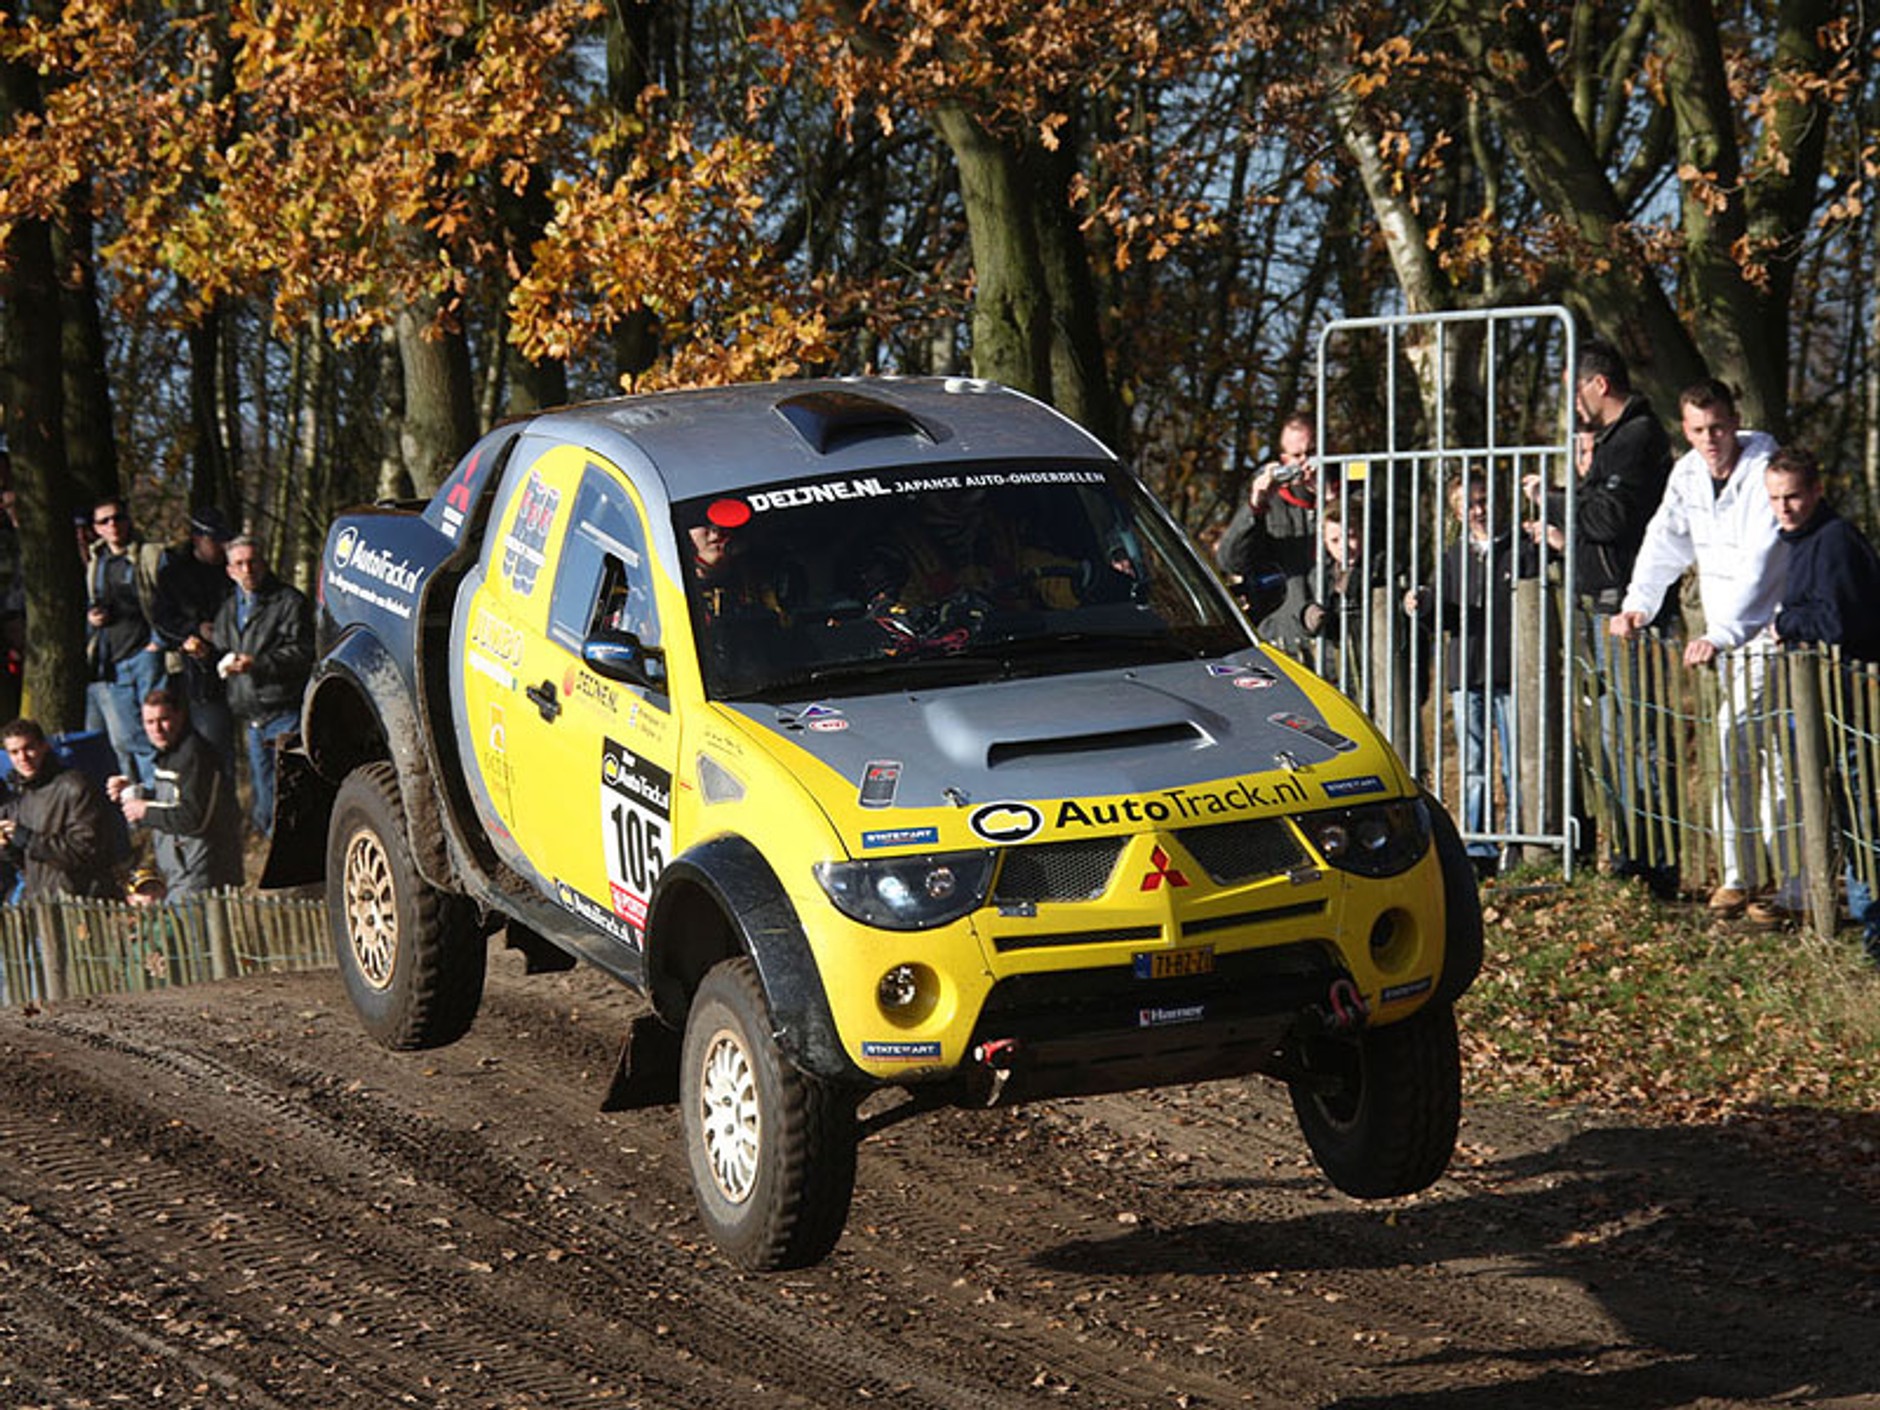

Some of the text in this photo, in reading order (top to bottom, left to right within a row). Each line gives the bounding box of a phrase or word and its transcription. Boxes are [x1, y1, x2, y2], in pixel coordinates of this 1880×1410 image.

[747, 471, 1106, 512] DEIJNE.NL JAPANSE AUTO-ONDERDELEN
[1055, 775, 1309, 829] AutoTrack.nl
[611, 803, 664, 897] 105
